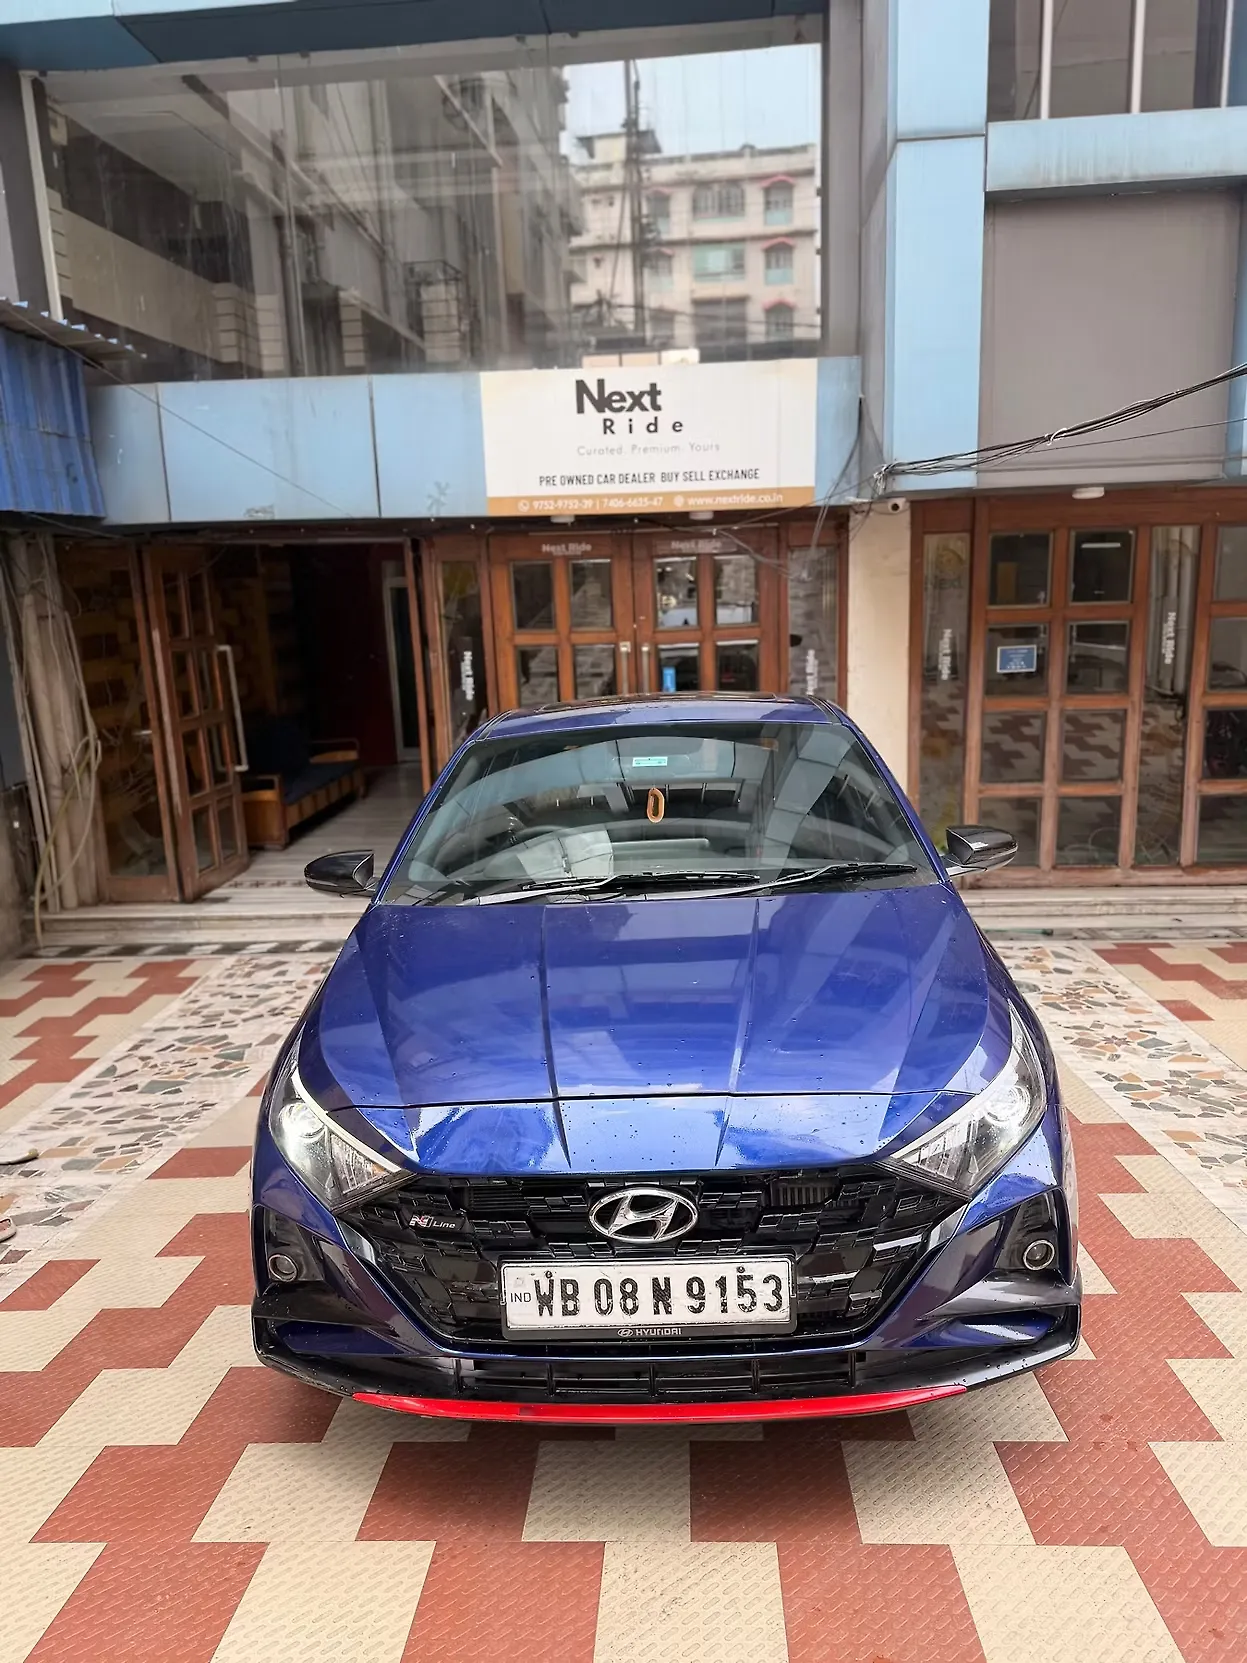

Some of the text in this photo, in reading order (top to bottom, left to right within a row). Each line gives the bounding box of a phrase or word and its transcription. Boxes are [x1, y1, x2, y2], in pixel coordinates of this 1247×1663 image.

[575, 378, 662, 414] Next
[602, 416, 684, 435] Ride
[689, 441, 721, 453] Yours
[539, 468, 760, 487] PRE OWNED CAR DEALER BUY SELL EXCHANGE
[687, 492, 783, 506] www.nextride.co.in
[433, 1220, 456, 1229] Line
[510, 1274, 783, 1317] IND WB 08 N 9153
[635, 1328, 682, 1336] HYUNDAI
